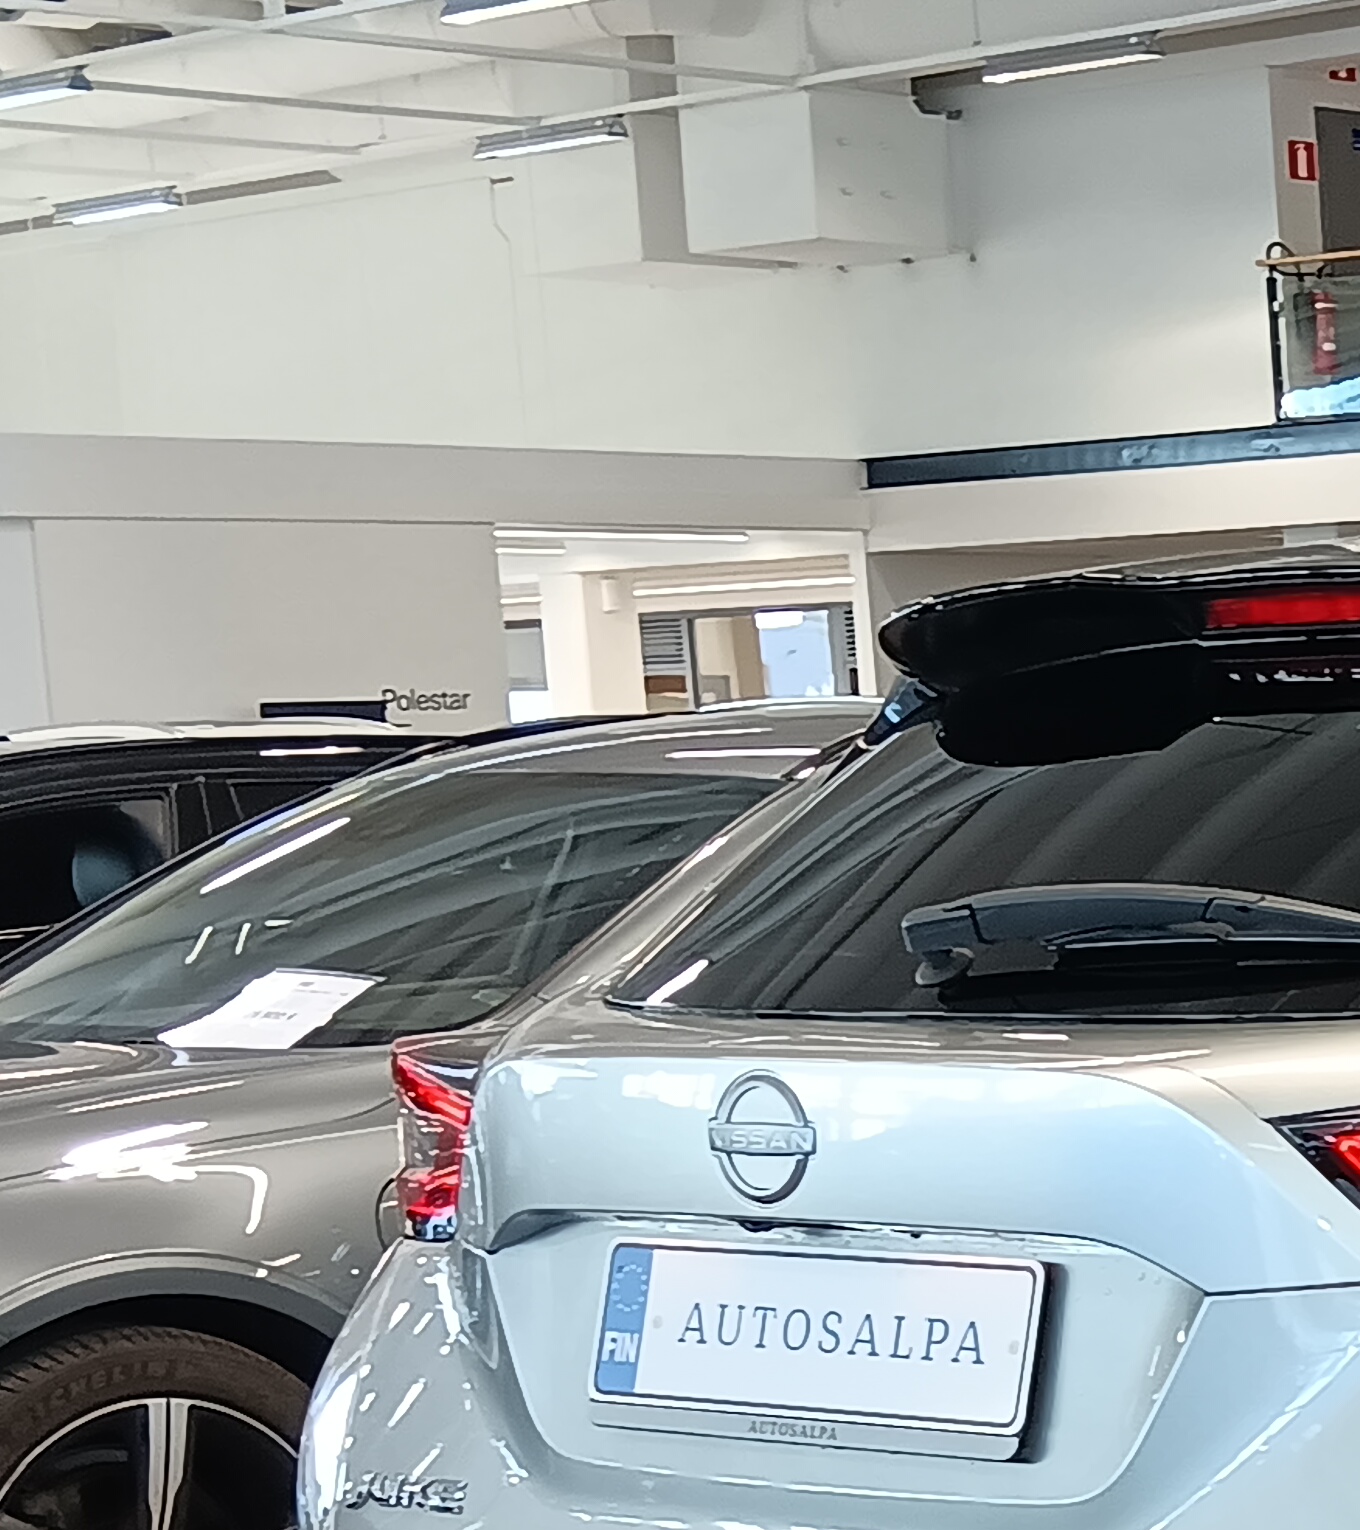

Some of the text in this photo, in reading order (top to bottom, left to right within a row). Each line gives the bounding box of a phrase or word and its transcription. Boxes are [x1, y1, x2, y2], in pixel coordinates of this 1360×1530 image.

[381, 688, 471, 711] Polestar
[602, 1330, 641, 1364] FIN
[677, 1302, 986, 1365] AUTOSALPA
[747, 1420, 838, 1440] AUTOSALPA
